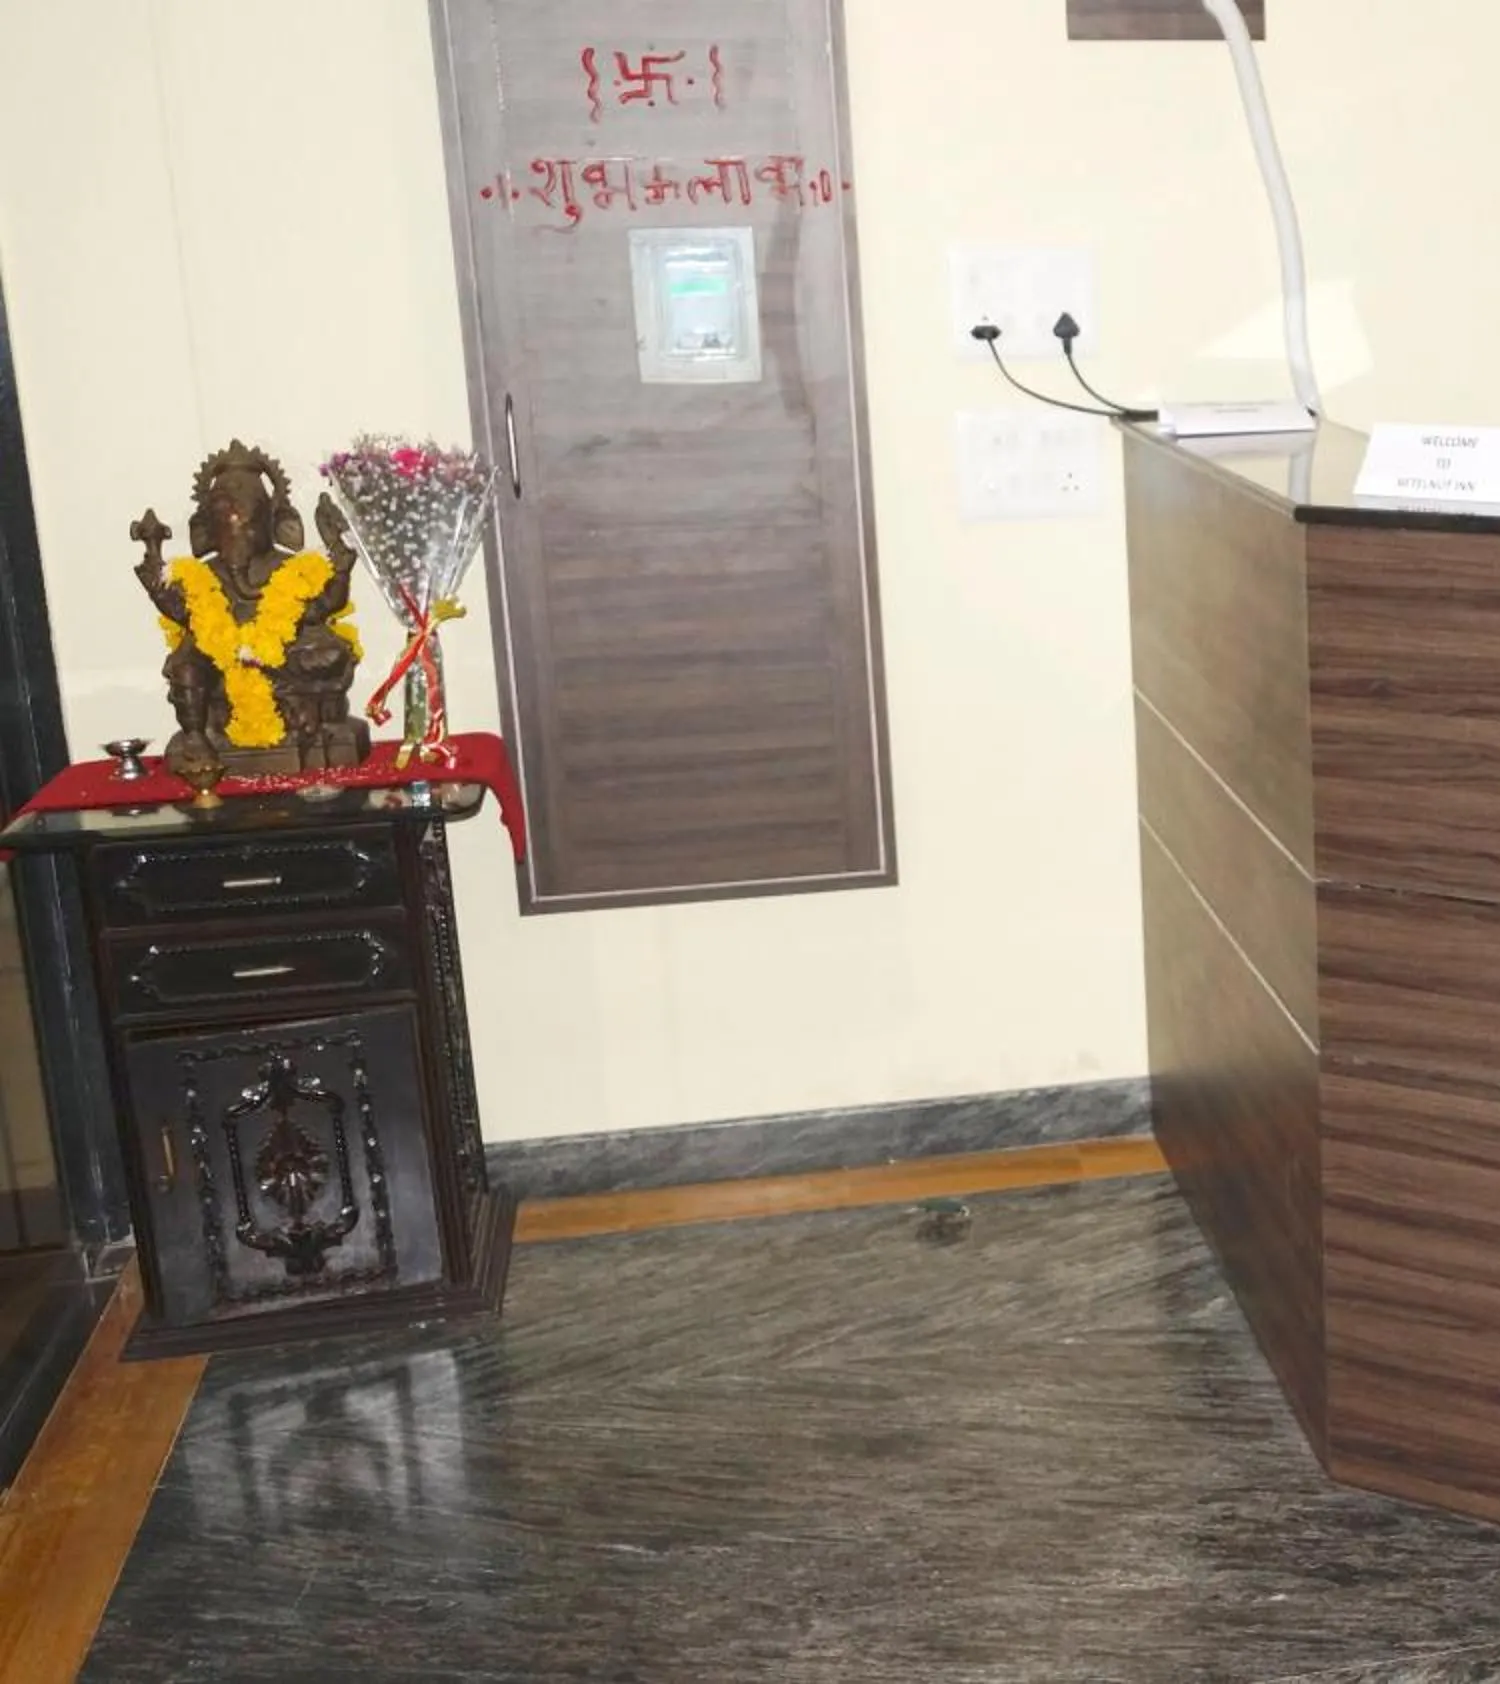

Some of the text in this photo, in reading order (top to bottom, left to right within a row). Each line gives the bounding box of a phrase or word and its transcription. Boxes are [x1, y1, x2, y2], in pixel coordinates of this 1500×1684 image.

[1421, 435, 1480, 448] WELCOME
[1436, 457, 1451, 469] TO
[1455, 480, 1476, 492] INN
